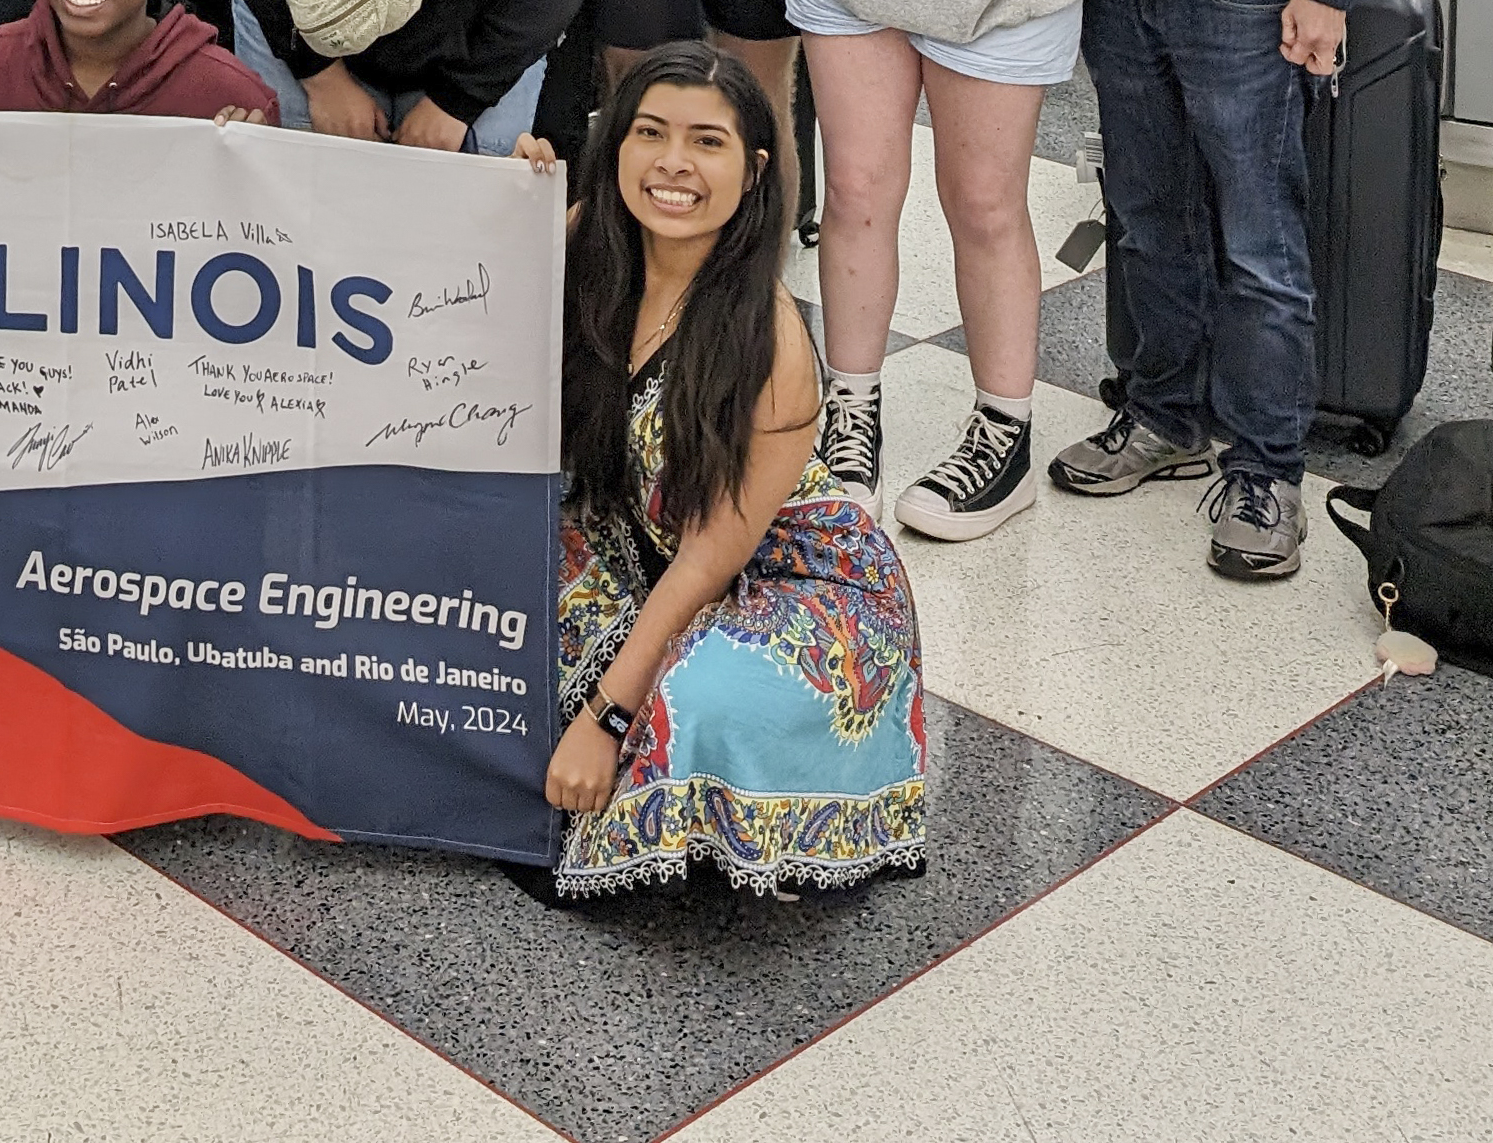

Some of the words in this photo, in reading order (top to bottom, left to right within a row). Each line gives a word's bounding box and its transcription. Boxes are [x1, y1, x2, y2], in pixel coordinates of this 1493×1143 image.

[150, 220, 229, 242] ISABELA
[11, 356, 34, 375] YOU
[105, 349, 154, 372] Vidhi
[187, 354, 236, 381] THANK
[408, 356, 455, 377] Ryan
[108, 369, 158, 395] Patel
[203, 383, 230, 400] LOVE
[233, 389, 254, 406] YOU
[15, 550, 247, 617] Aerospace
[258, 572, 528, 651] Engineering
[58, 626, 102, 654] São
[107, 632, 181, 666] Paulo,
[187, 641, 294, 670] Ubatuba
[300, 653, 348, 678] and
[355, 654, 395, 681] Rio
[400, 657, 430, 684] de
[435, 660, 528, 696] Janeiro
[396, 700, 456, 735] May,
[460, 704, 530, 737] 2024
